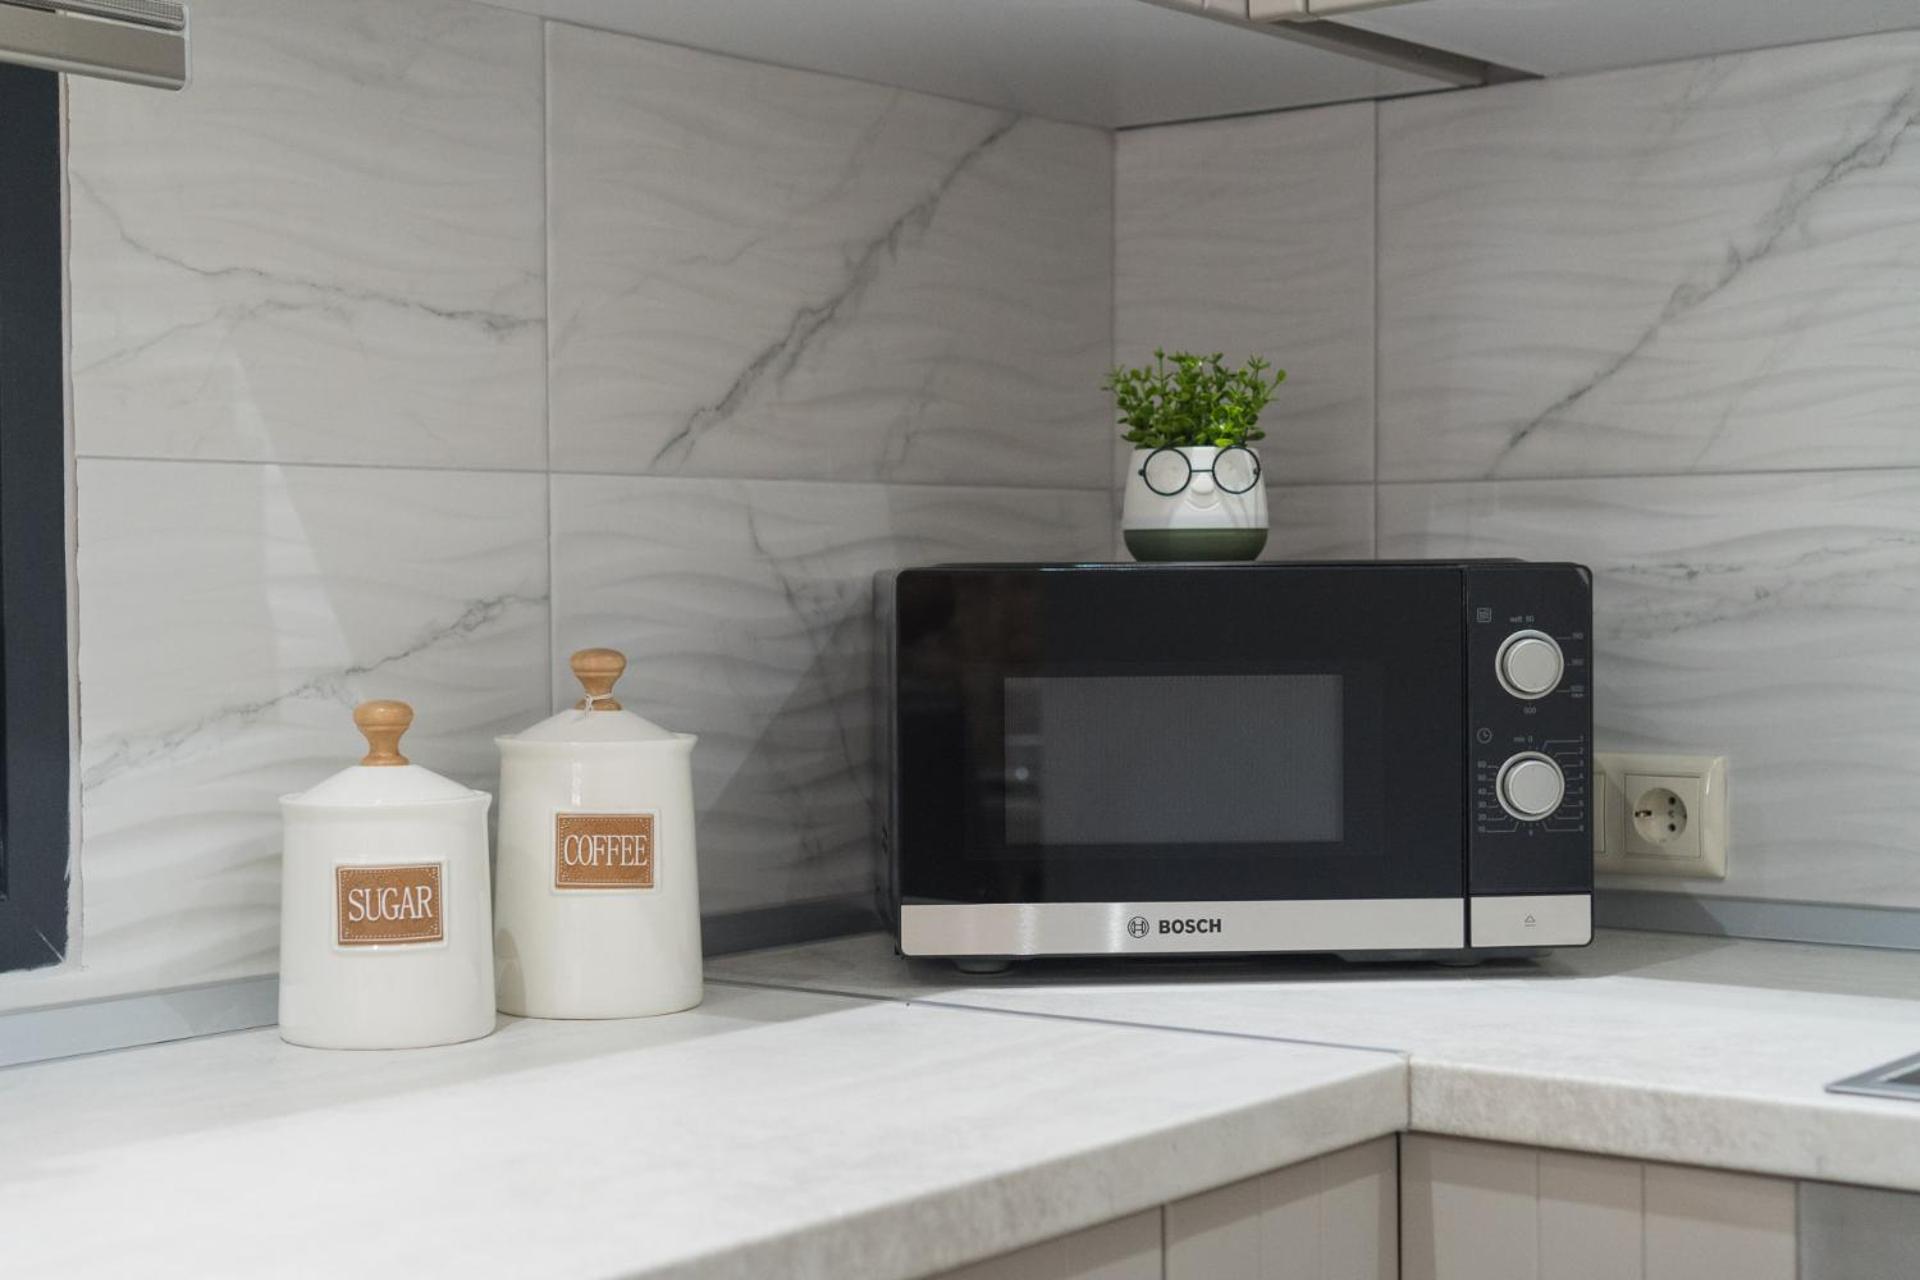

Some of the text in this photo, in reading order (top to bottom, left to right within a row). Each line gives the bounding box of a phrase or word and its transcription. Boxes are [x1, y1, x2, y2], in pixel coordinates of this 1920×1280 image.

[563, 834, 648, 868] COFFEE
[348, 885, 433, 922] SUGAR
[1158, 918, 1222, 934] BOSCH
